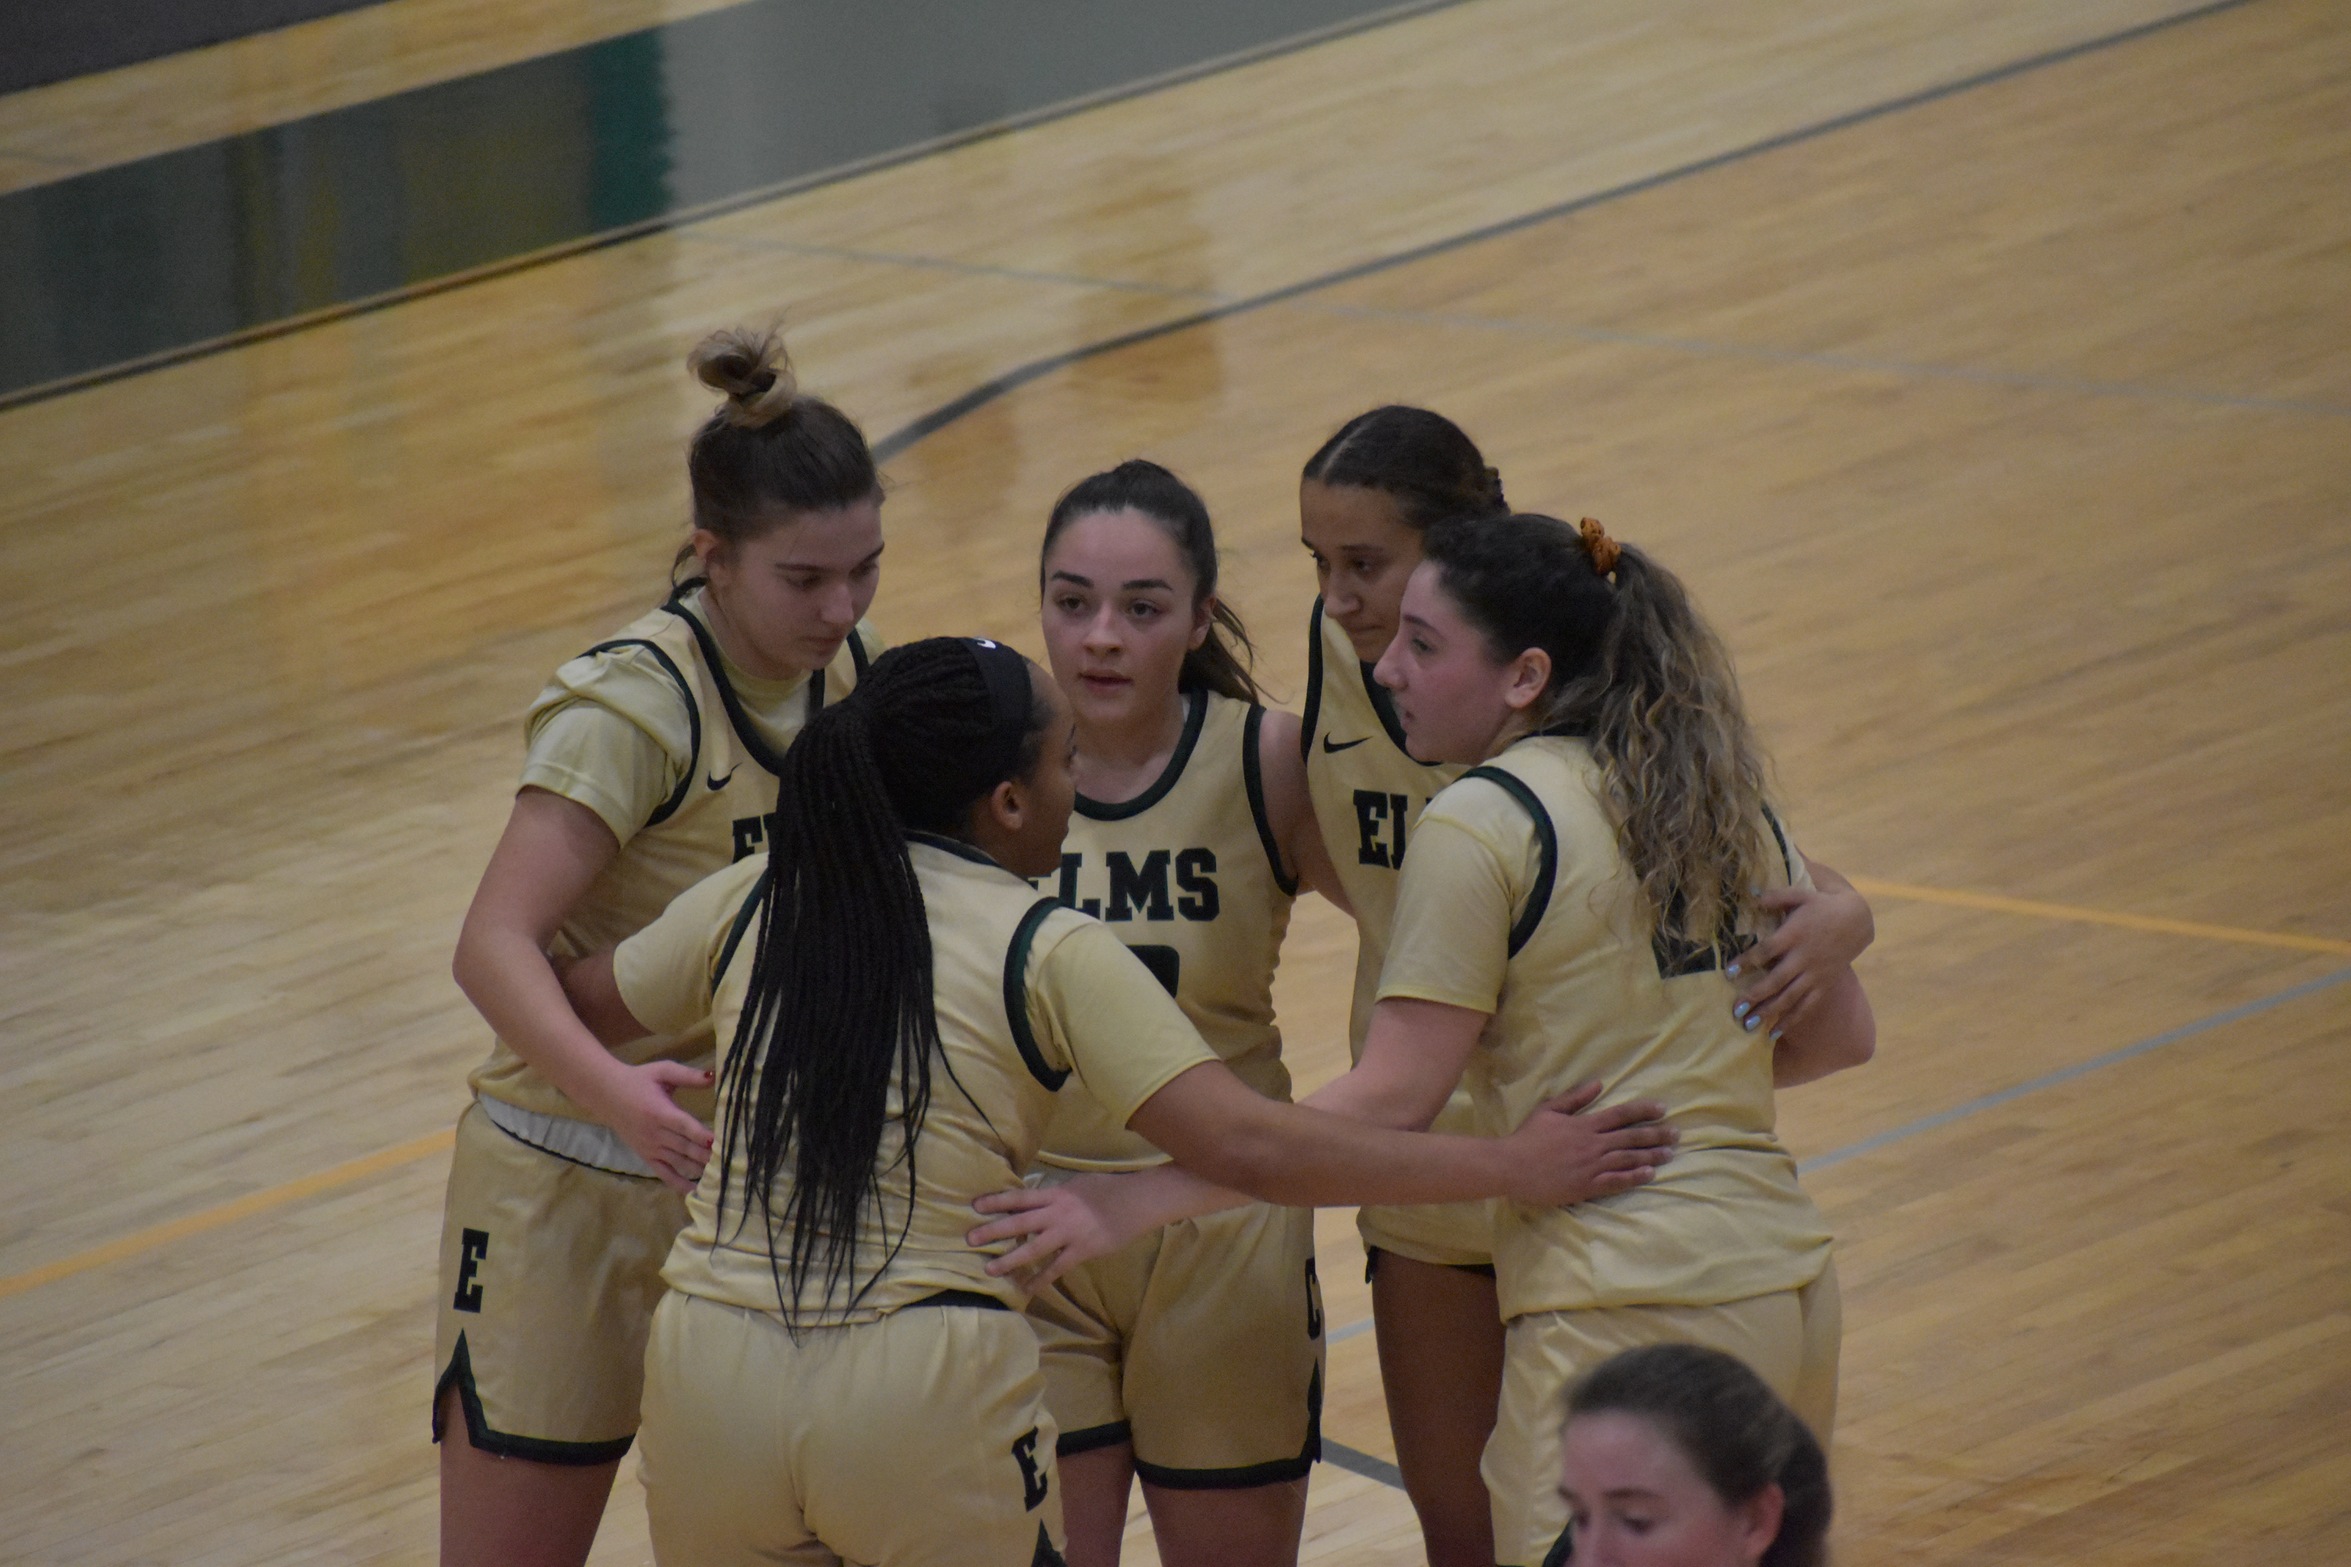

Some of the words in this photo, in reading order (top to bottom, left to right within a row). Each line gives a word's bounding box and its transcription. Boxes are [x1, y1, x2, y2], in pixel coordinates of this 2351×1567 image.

[1029, 847, 1219, 921] LMS
[453, 1227, 489, 1313] E
[1011, 1425, 1048, 1512] E
